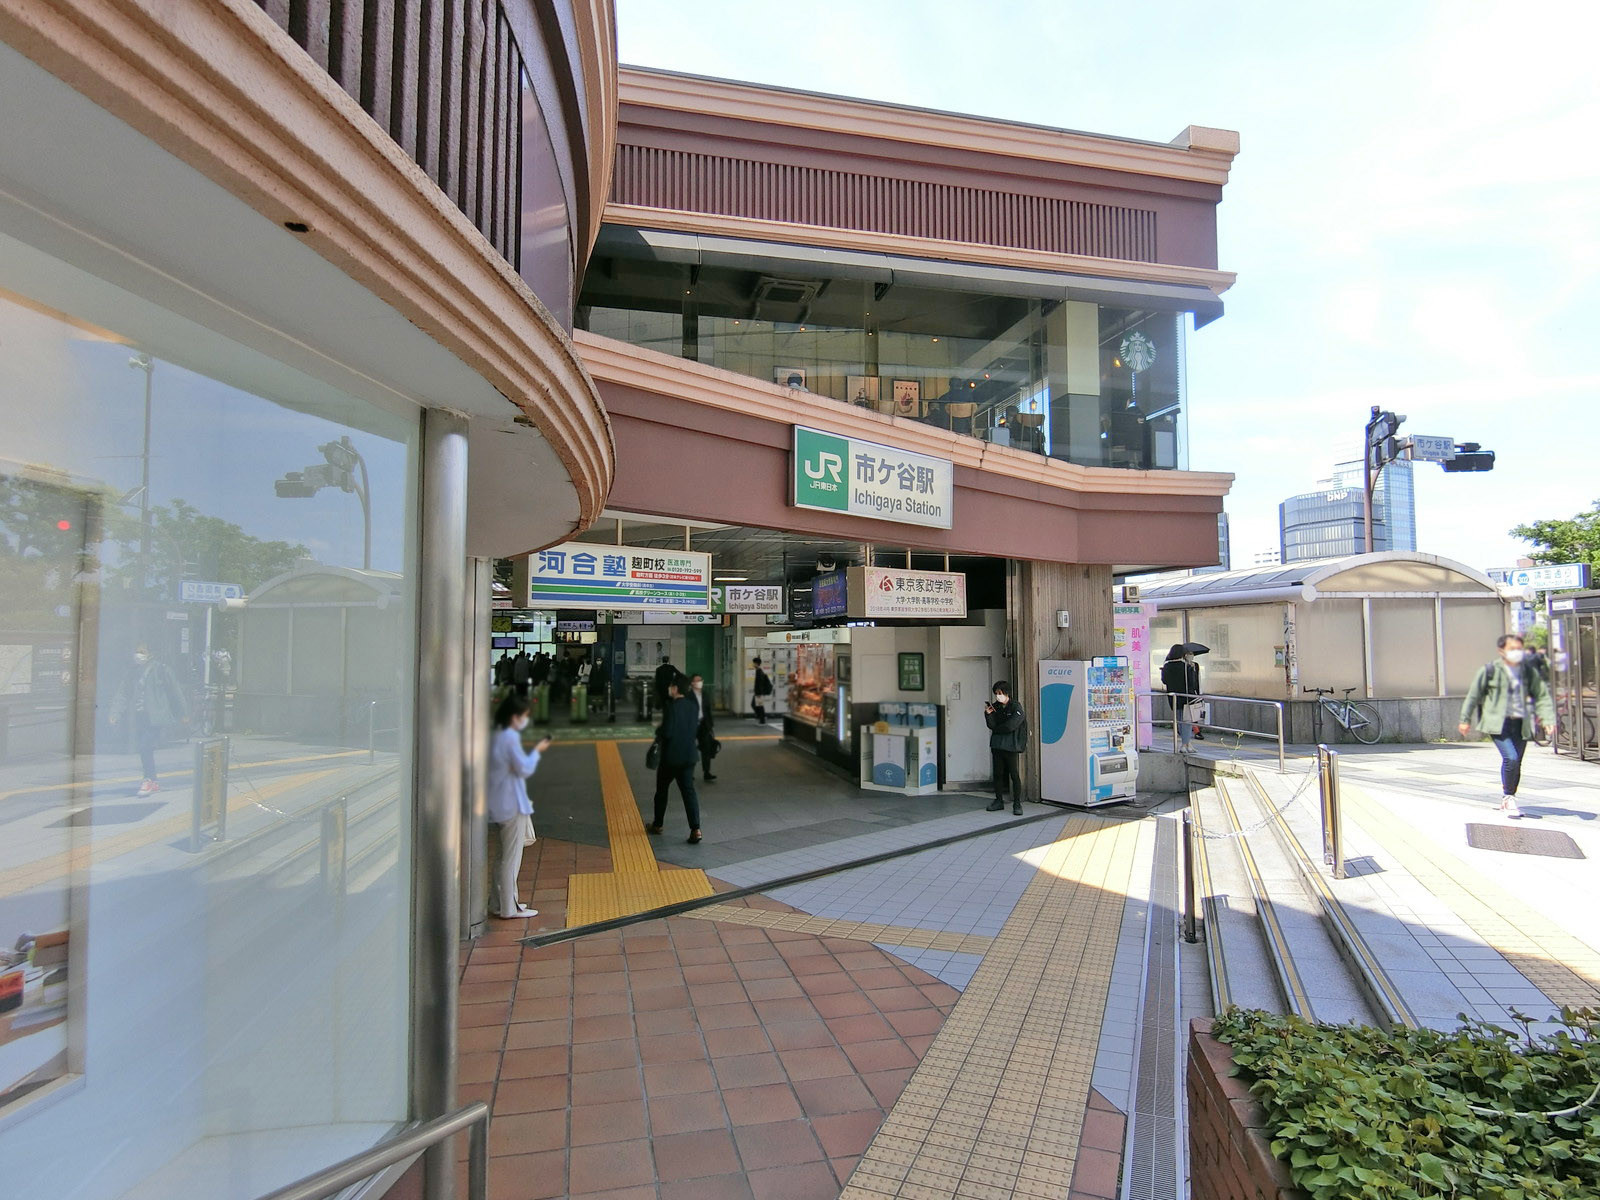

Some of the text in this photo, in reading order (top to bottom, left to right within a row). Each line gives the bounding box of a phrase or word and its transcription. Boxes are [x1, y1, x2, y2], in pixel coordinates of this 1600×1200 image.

[804, 451, 842, 483] JR
[809, 480, 838, 492] JR東日本
[854, 487, 942, 517] Ichigaya Station
[1327, 491, 1348, 502] DNP
[538, 550, 627, 577] 河合塾
[895, 577, 953, 594] 東京家政学院
[728, 602, 755, 611] Ichigaya
[756, 602, 778, 610] Station
[1047, 668, 1073, 676] acure
